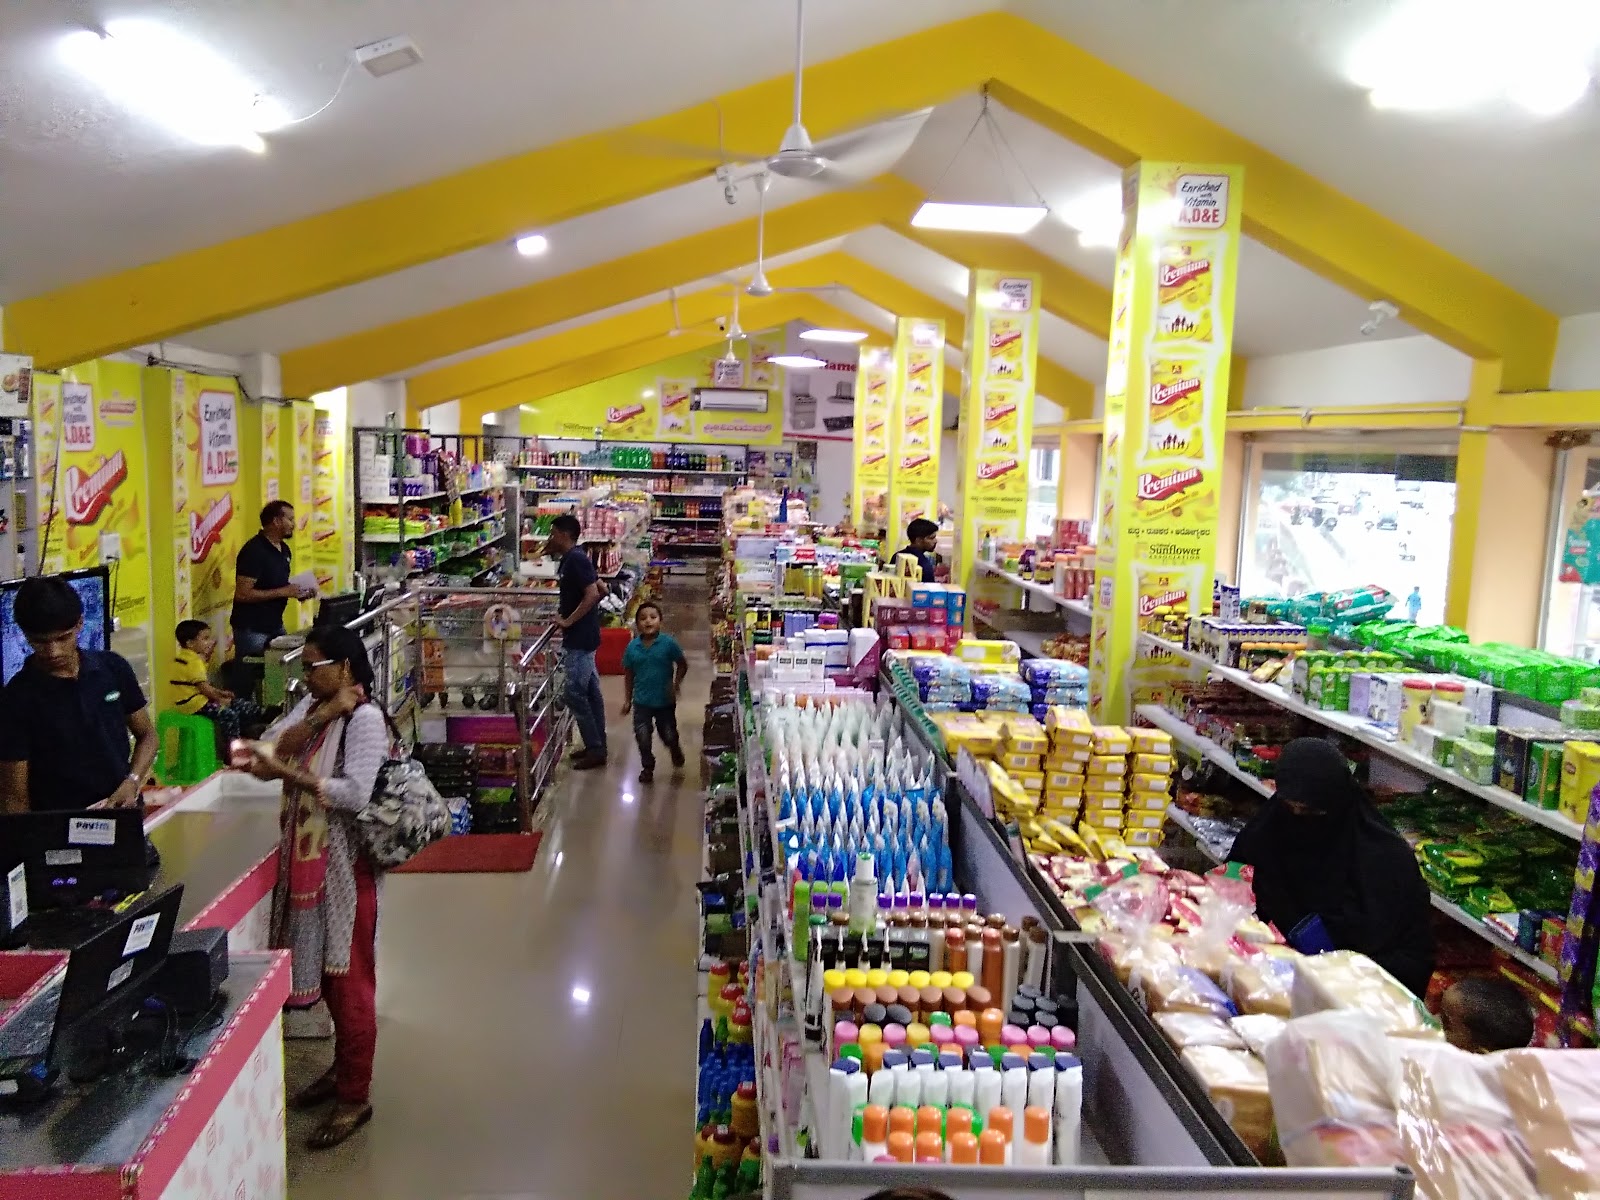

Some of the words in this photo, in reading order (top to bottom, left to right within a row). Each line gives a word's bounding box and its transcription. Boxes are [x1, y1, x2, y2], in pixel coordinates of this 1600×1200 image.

[1180, 181, 1222, 193] Enriched
[1184, 197, 1217, 207] Vitamin
[1179, 208, 1219, 223] A,D&E
[1160, 258, 1210, 287] Premium
[1151, 377, 1201, 405] Premium
[204, 402, 232, 422] Enriched
[208, 428, 232, 448] Vitamin
[977, 459, 1018, 479] Premium
[1137, 466, 1202, 500] Premium
[1149, 544, 1202, 555] Sunflower
[1139, 590, 1187, 616] Premium
